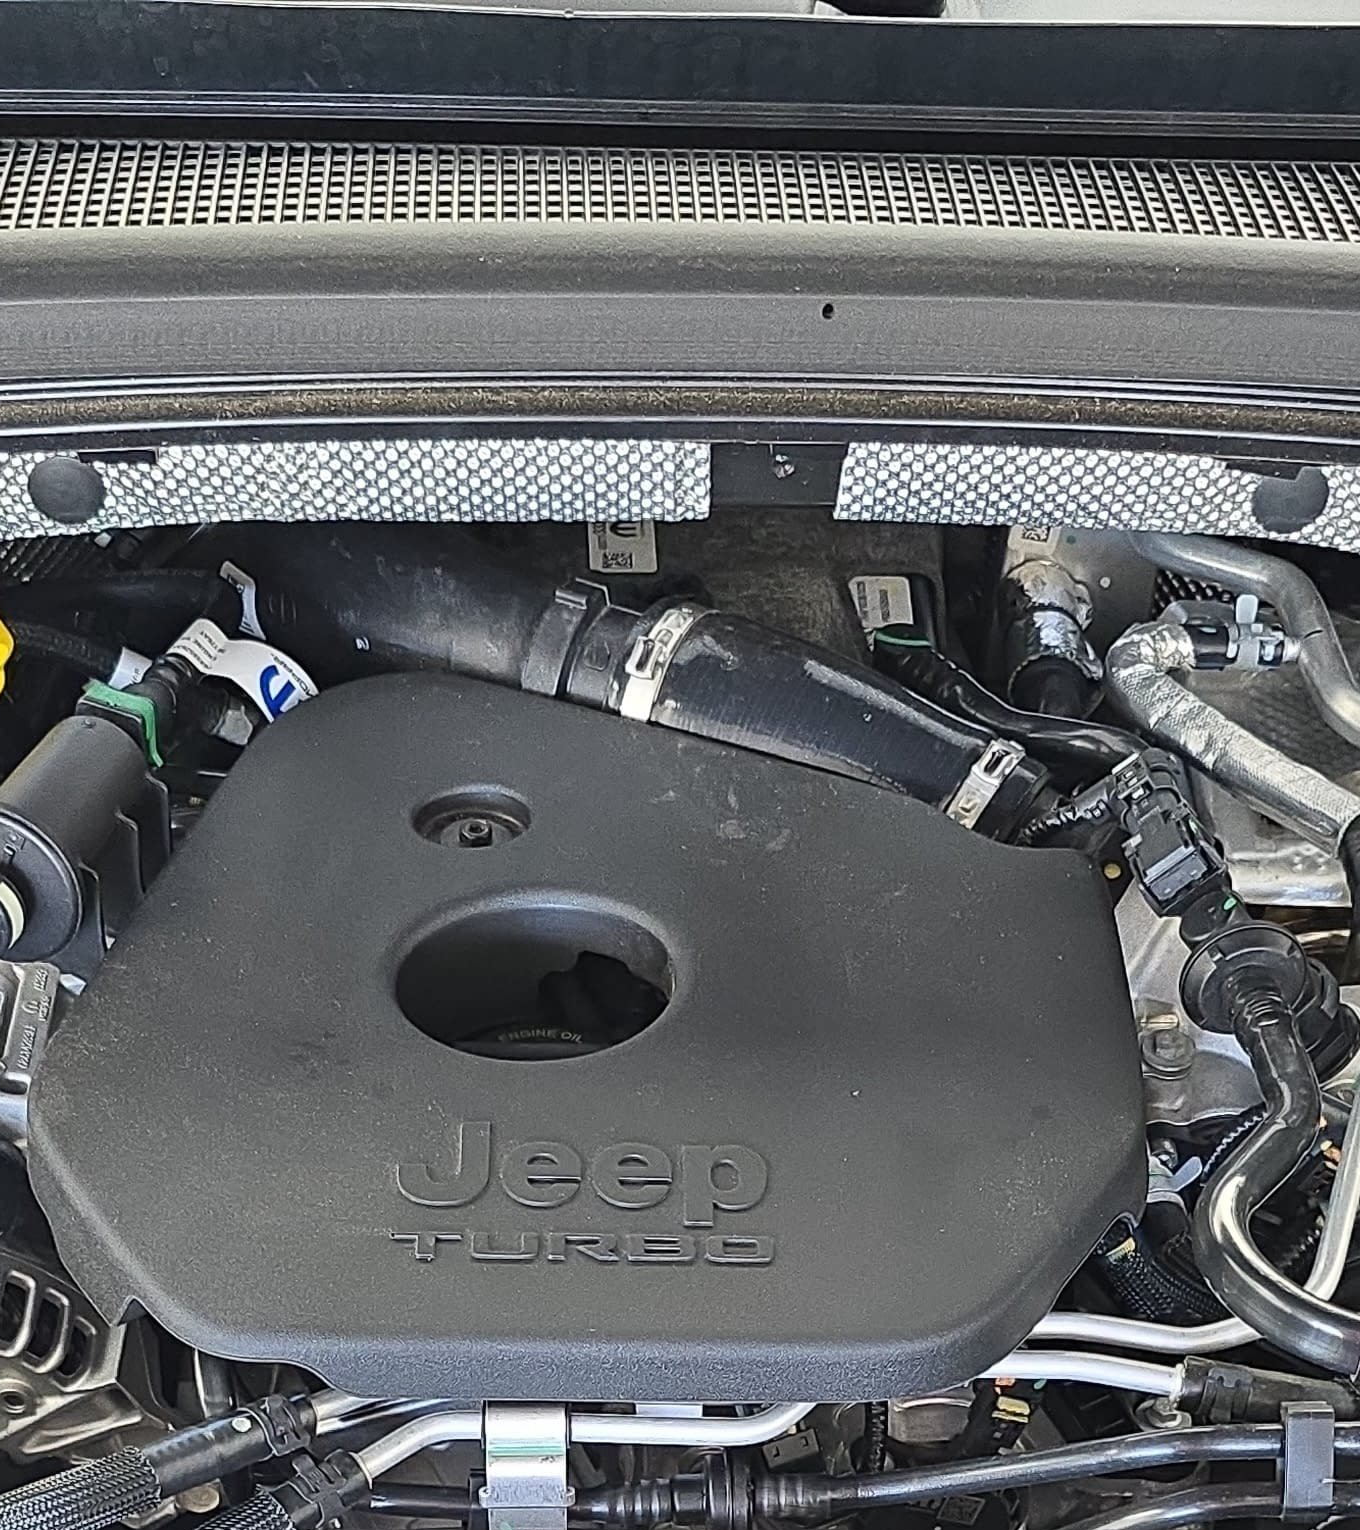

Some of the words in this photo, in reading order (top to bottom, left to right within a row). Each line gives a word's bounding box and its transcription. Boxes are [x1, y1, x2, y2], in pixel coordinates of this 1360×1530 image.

[497, 1028, 556, 1043] ENGINE
[560, 1030, 584, 1044] OIL
[396, 1121, 769, 1227] Jeep
[390, 1232, 776, 1265] TURBO
